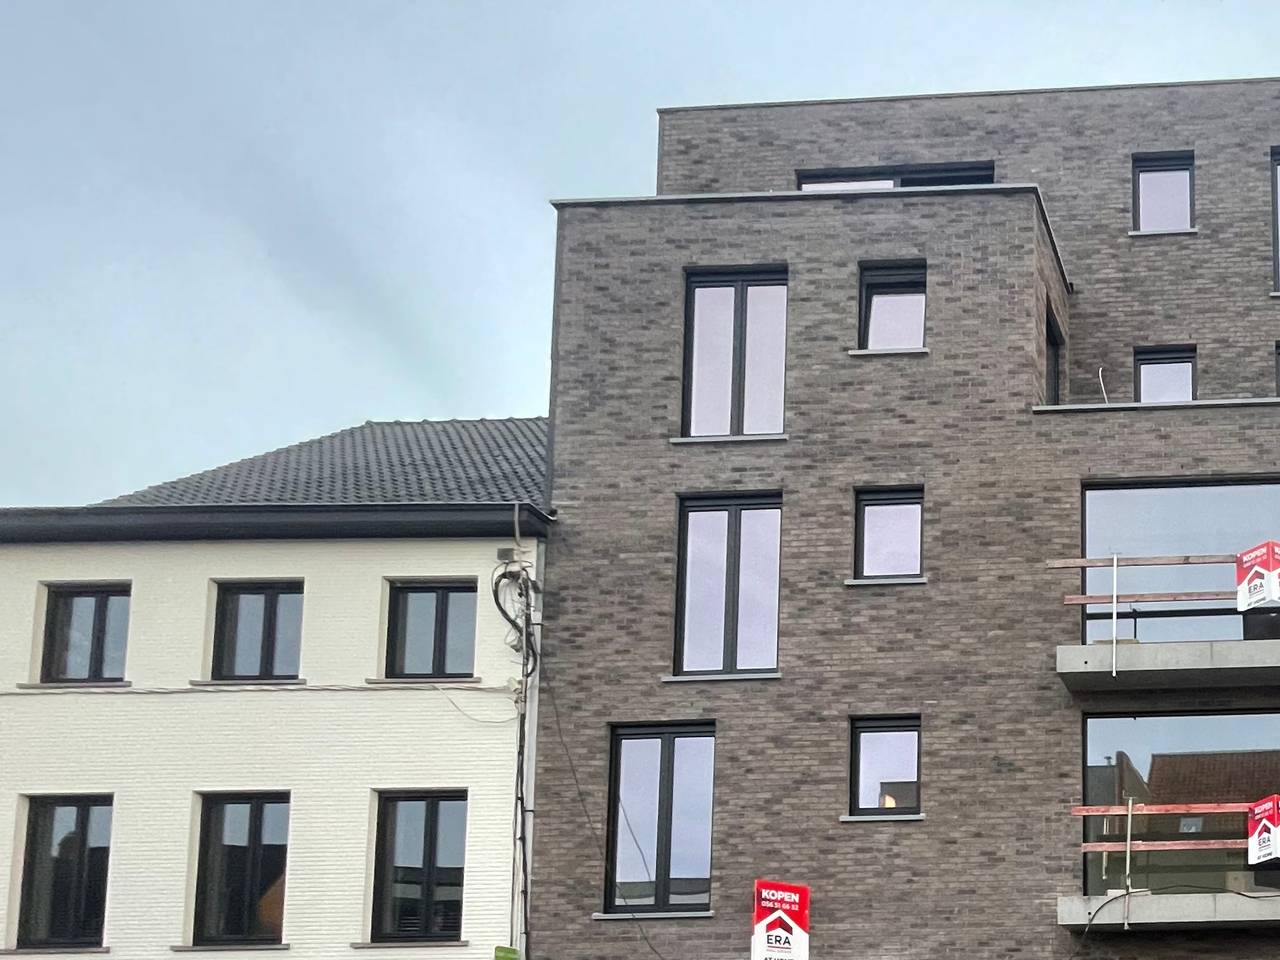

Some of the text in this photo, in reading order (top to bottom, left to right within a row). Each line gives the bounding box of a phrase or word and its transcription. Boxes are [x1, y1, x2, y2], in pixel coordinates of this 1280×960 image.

[1248, 581, 1264, 594] ERA
[1258, 836, 1271, 846] ERA
[761, 889, 799, 903] KOPEN
[767, 934, 791, 946] ERA
